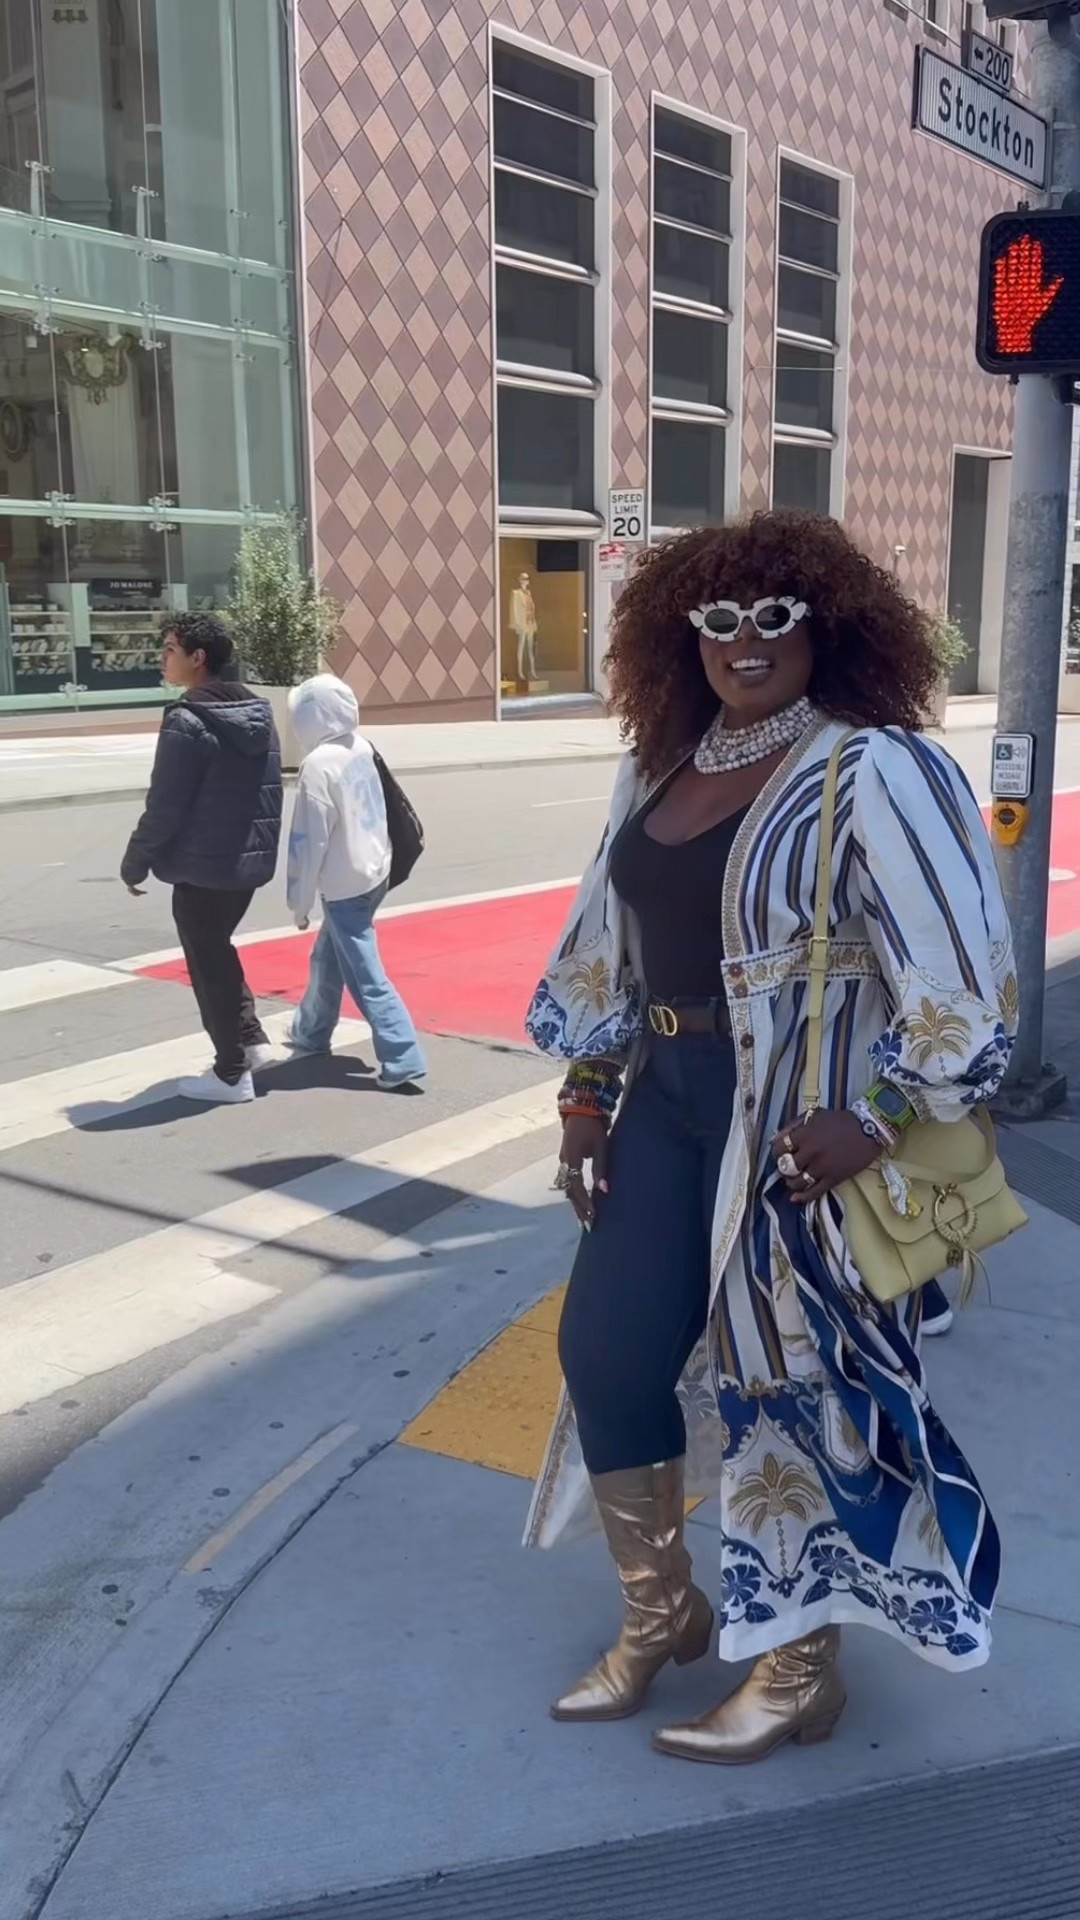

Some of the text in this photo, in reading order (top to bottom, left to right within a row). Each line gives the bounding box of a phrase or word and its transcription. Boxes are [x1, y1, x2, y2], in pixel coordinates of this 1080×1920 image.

[985, 46, 1010, 85] 200
[938, 77, 1034, 169] Stockton
[611, 493, 643, 503] SPEED
[614, 505, 639, 514] LIMIT
[613, 516, 641, 537] 20
[109, 581, 154, 589] JO MALONE
